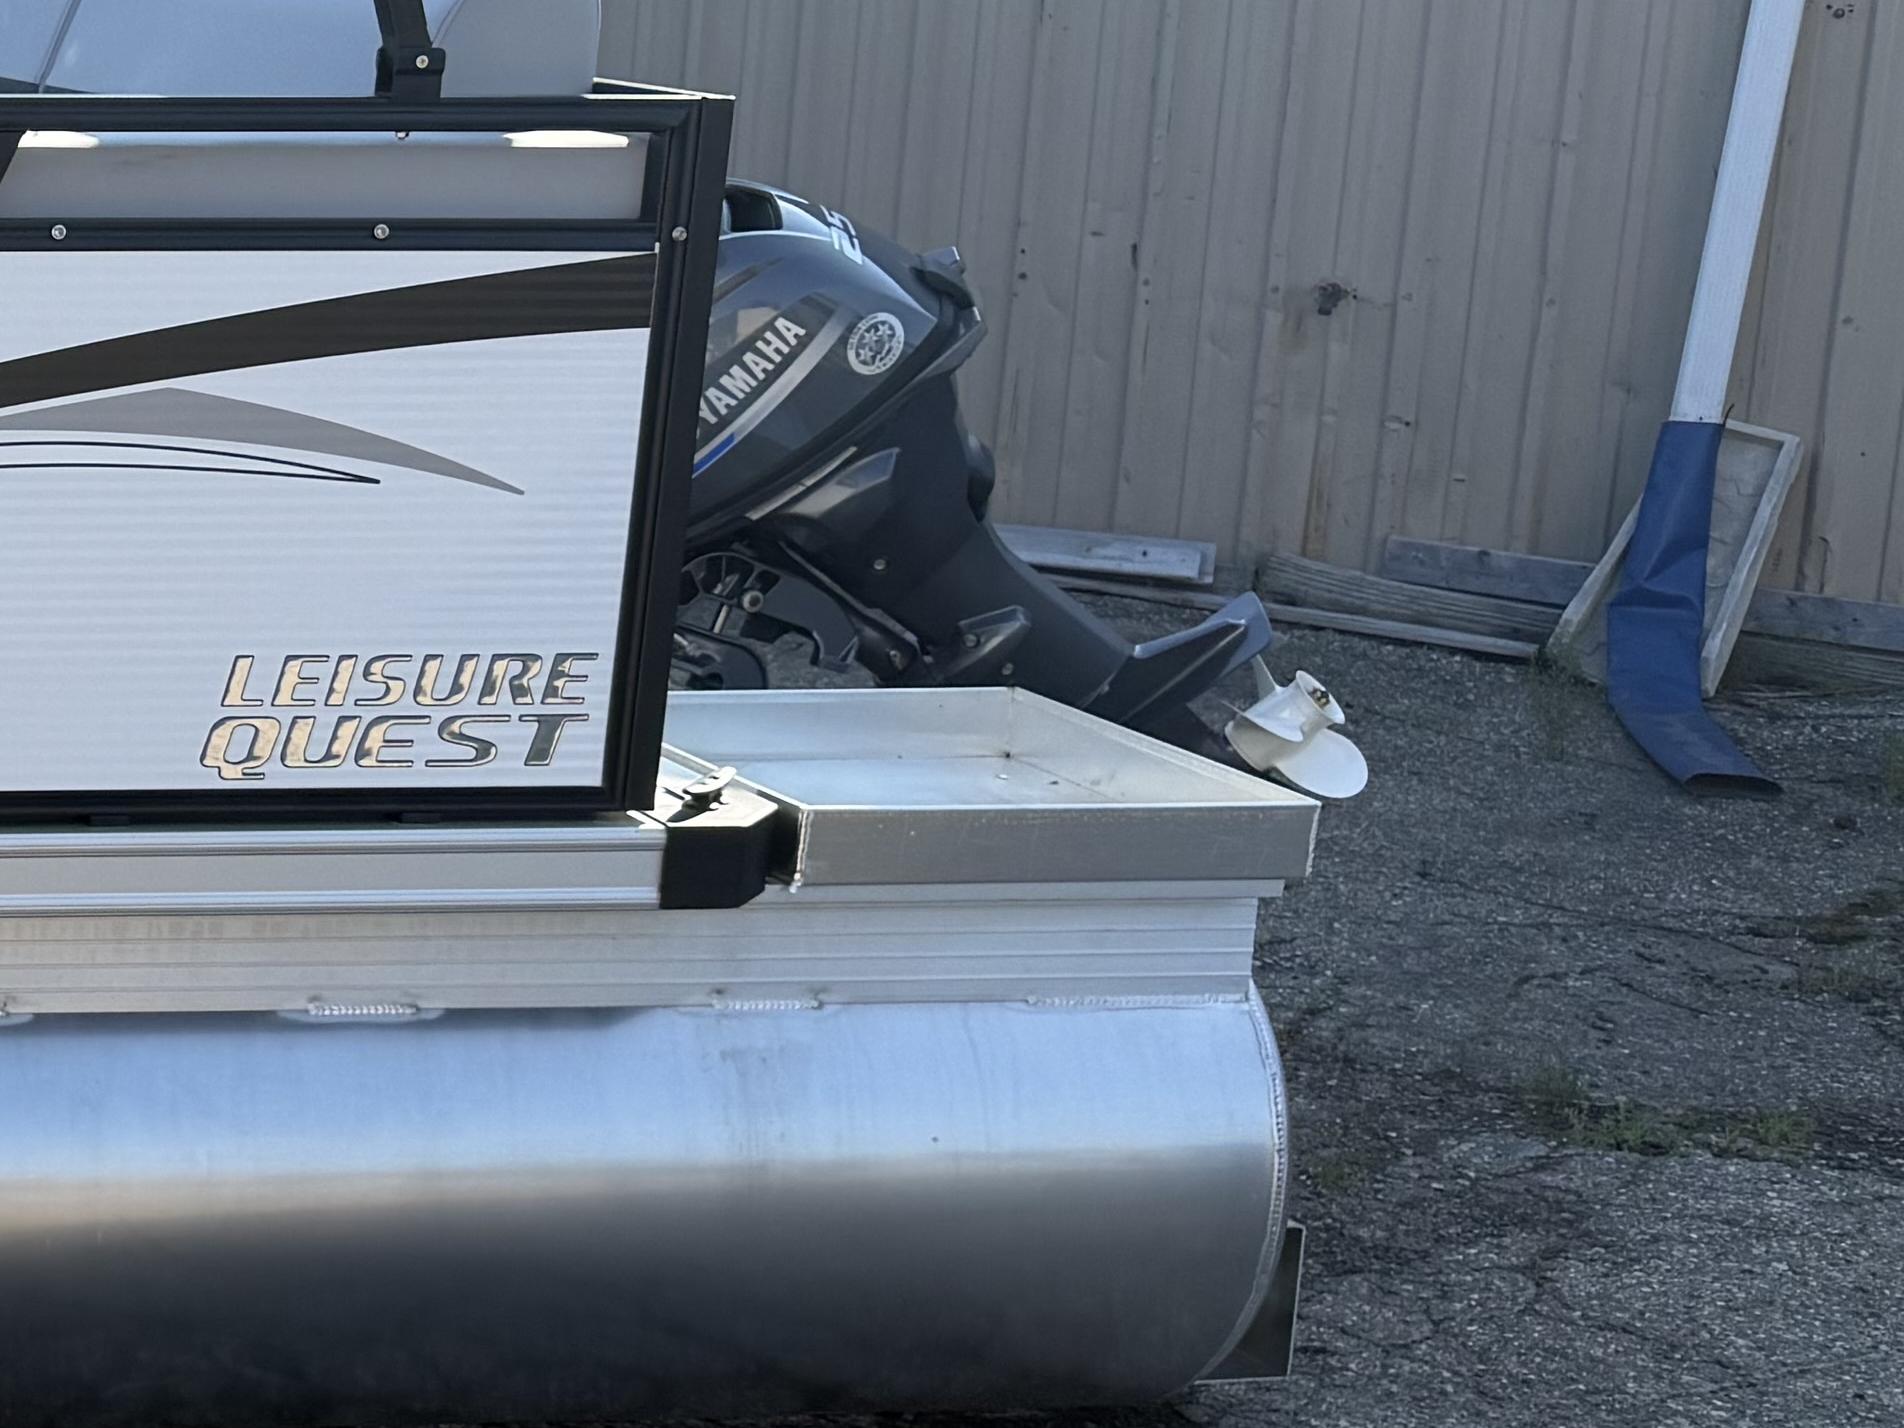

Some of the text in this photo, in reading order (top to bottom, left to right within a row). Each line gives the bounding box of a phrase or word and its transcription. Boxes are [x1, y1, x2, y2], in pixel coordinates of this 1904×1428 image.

[820, 204, 863, 265] 25
[698, 317, 807, 424] YAMAHA
[221, 652, 599, 707] LEISURE
[199, 713, 589, 780] QUEST
